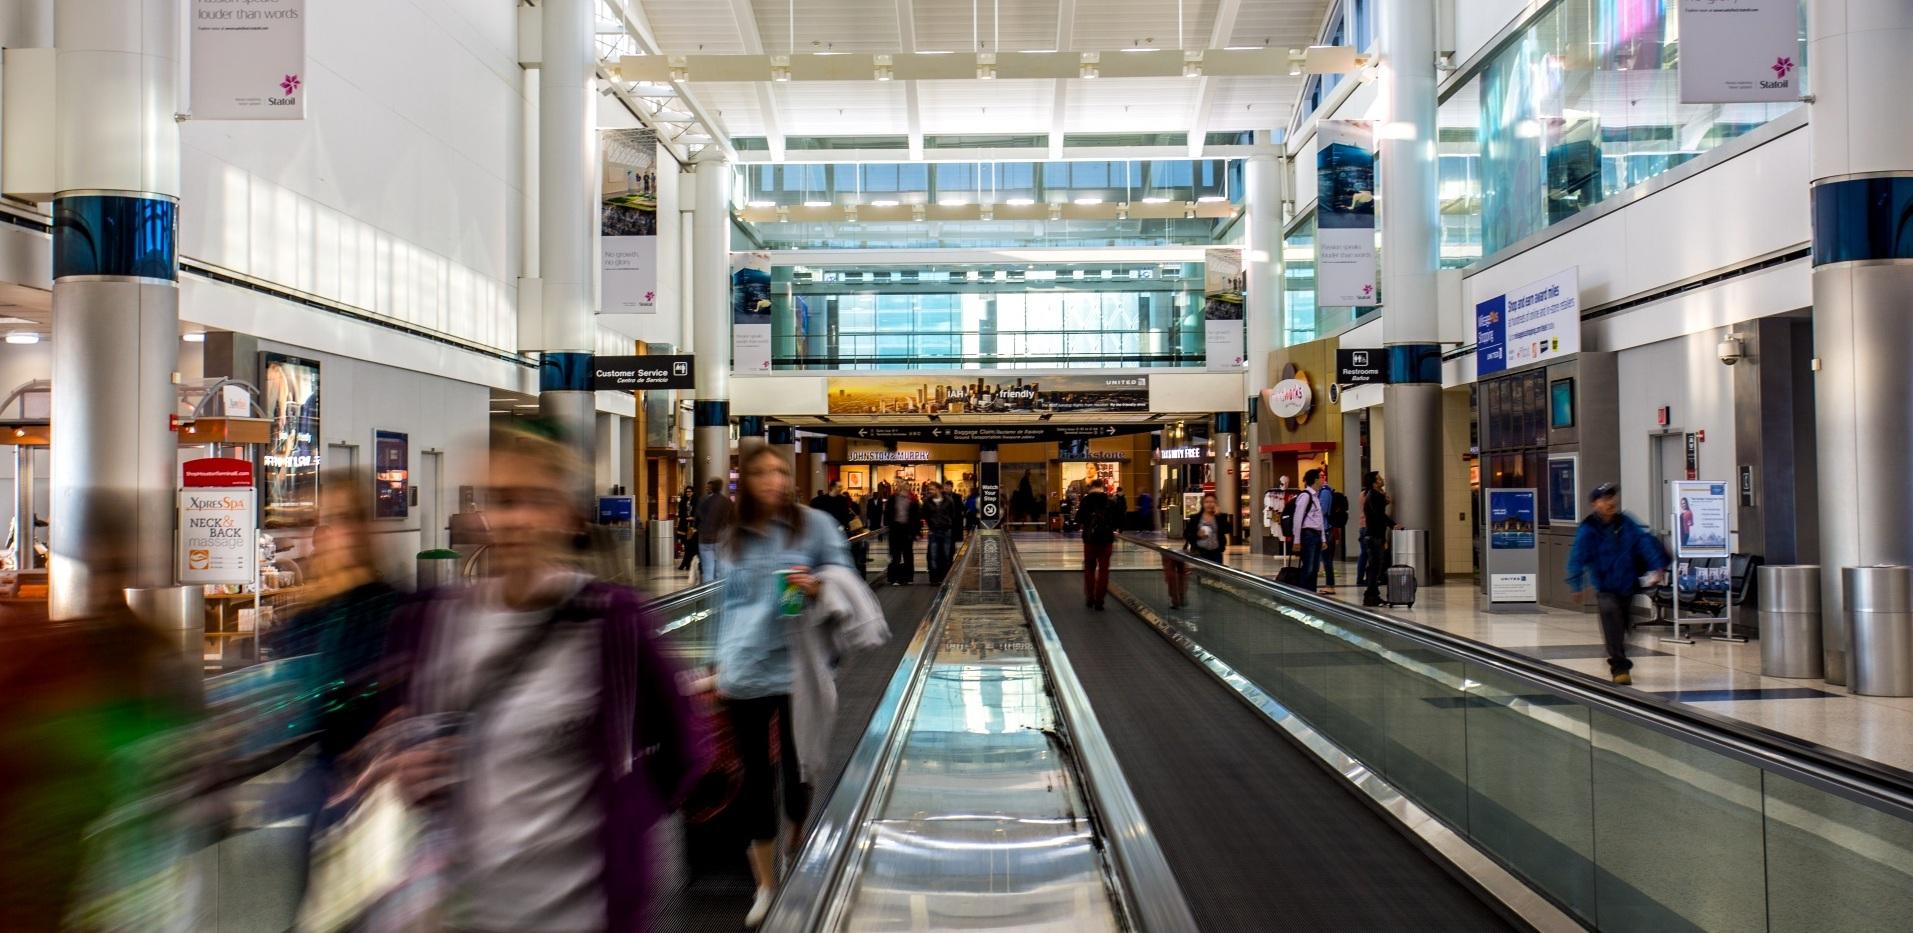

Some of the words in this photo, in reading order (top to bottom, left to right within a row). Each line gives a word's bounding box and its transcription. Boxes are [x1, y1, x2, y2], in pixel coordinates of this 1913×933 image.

[198, 9, 232, 19] louder
[236, 9, 261, 19] than
[264, 8, 298, 19] words
[1760, 80, 1788, 89] Statoil
[268, 97, 296, 106] Statoil
[1525, 295, 1534, 307] earn
[1535, 289, 1547, 304] award
[1548, 284, 1560, 299] miles
[596, 370, 635, 378] Customer
[638, 369, 669, 378] Service
[947, 390, 964, 398] IAH
[999, 389, 1035, 400] friendly
[849, 451, 890, 462] JOHNSTON
[897, 451, 929, 461] MURPHY
[1184, 448, 1201, 459] FREE
[190, 518, 222, 528] NECK
[209, 528, 242, 538] BACK
[189, 537, 244, 550] massage
